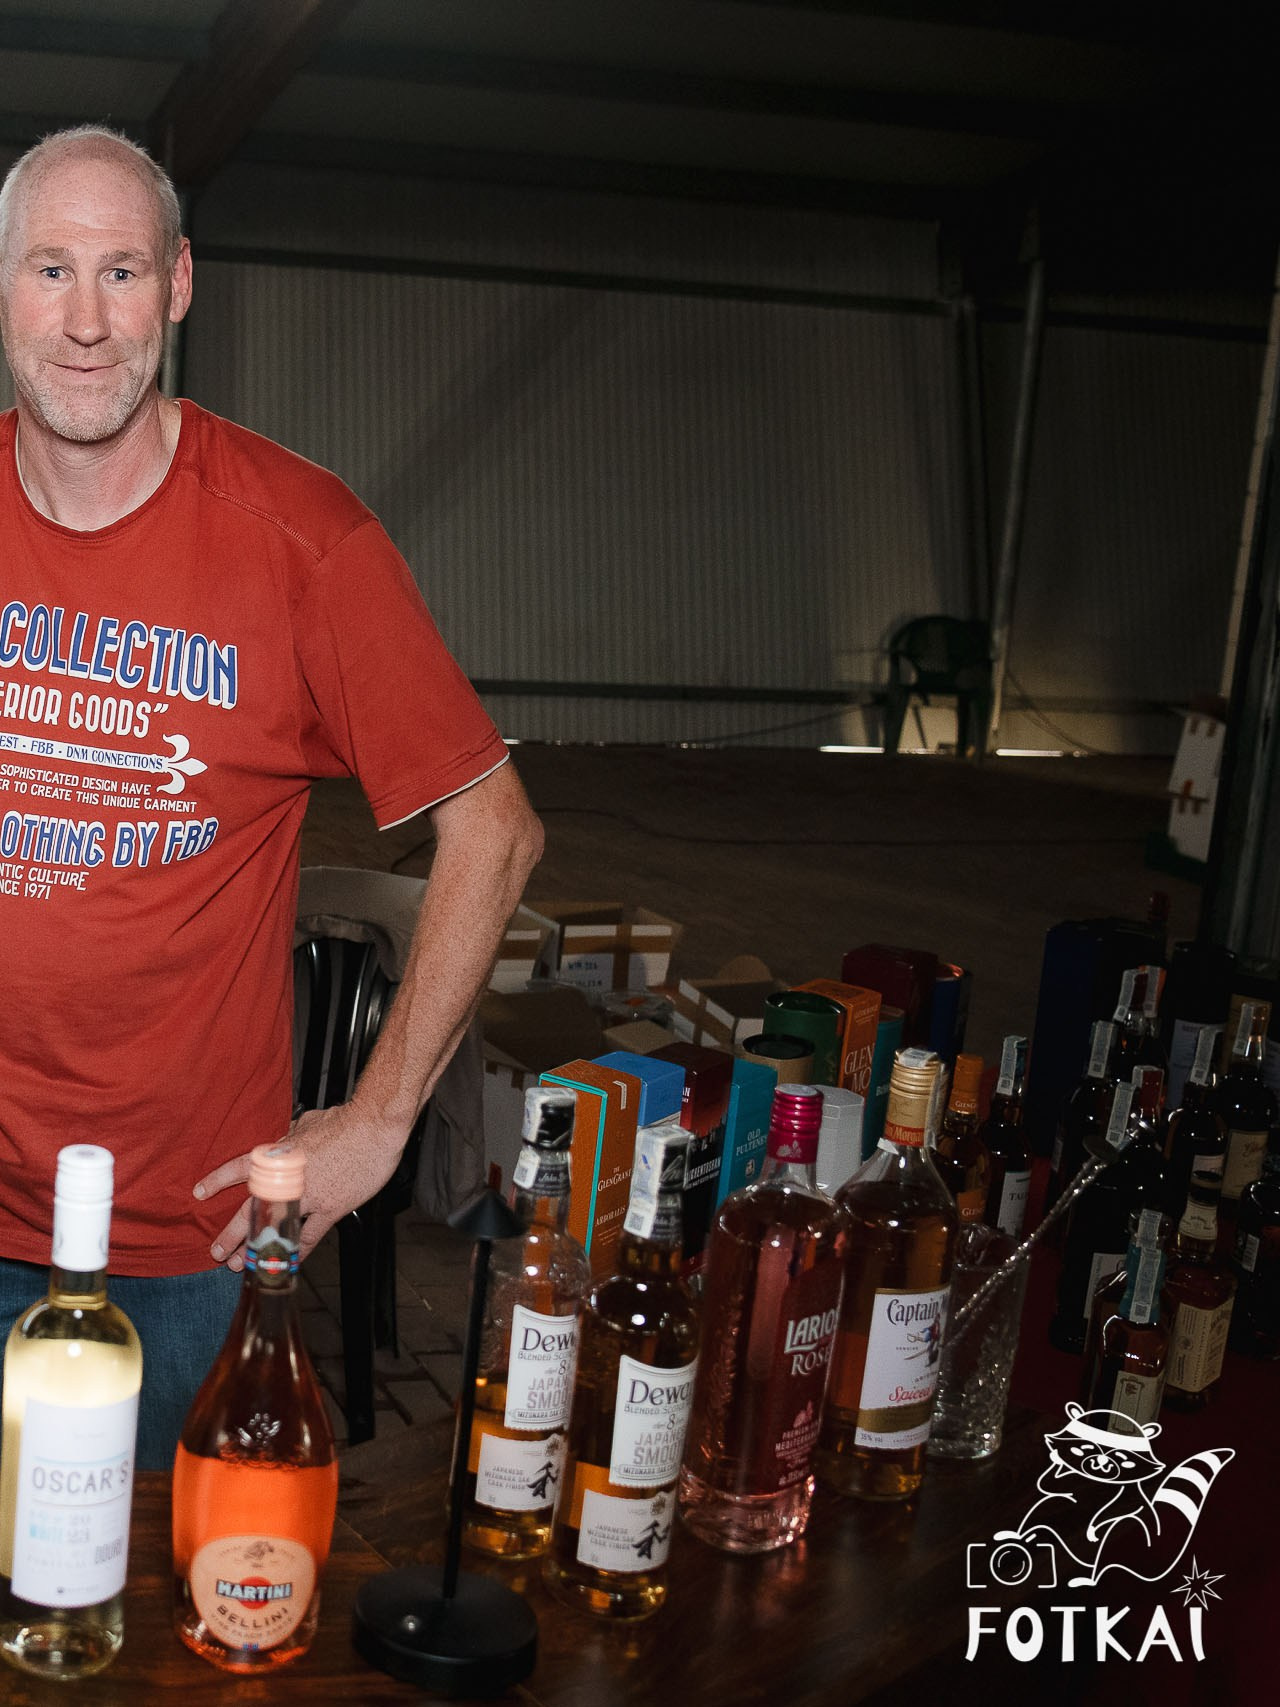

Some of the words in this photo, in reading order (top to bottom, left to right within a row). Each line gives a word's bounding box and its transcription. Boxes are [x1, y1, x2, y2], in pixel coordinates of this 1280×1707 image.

[30, 740, 55, 755] FBB
[66, 745, 88, 761] DNM
[91, 749, 164, 770] CONNECTIONS
[0, 763, 80, 787] SOPHISTICATED
[82, 776, 118, 793] DESIGN
[121, 782, 152, 796] HAVE
[14, 780, 28, 794] TO
[30, 783, 73, 802] CREATE
[76, 790, 100, 805] THIS
[102, 794, 141, 809] UNIQUE
[144, 798, 198, 813] GARMENT
[112, 820, 160, 868] BY
[161, 816, 220, 865] FBB
[24, 882, 52, 900] 1971
[28, 866, 90, 891] CULTURE
[887, 1297, 940, 1326] Captain
[521, 1326, 575, 1353] Dew
[527, 1374, 569, 1391] JAPAN
[31, 1460, 130, 1494] OSCAR'S
[216, 1580, 292, 1601] MARTINI
[216, 1604, 289, 1628] BELLINI
